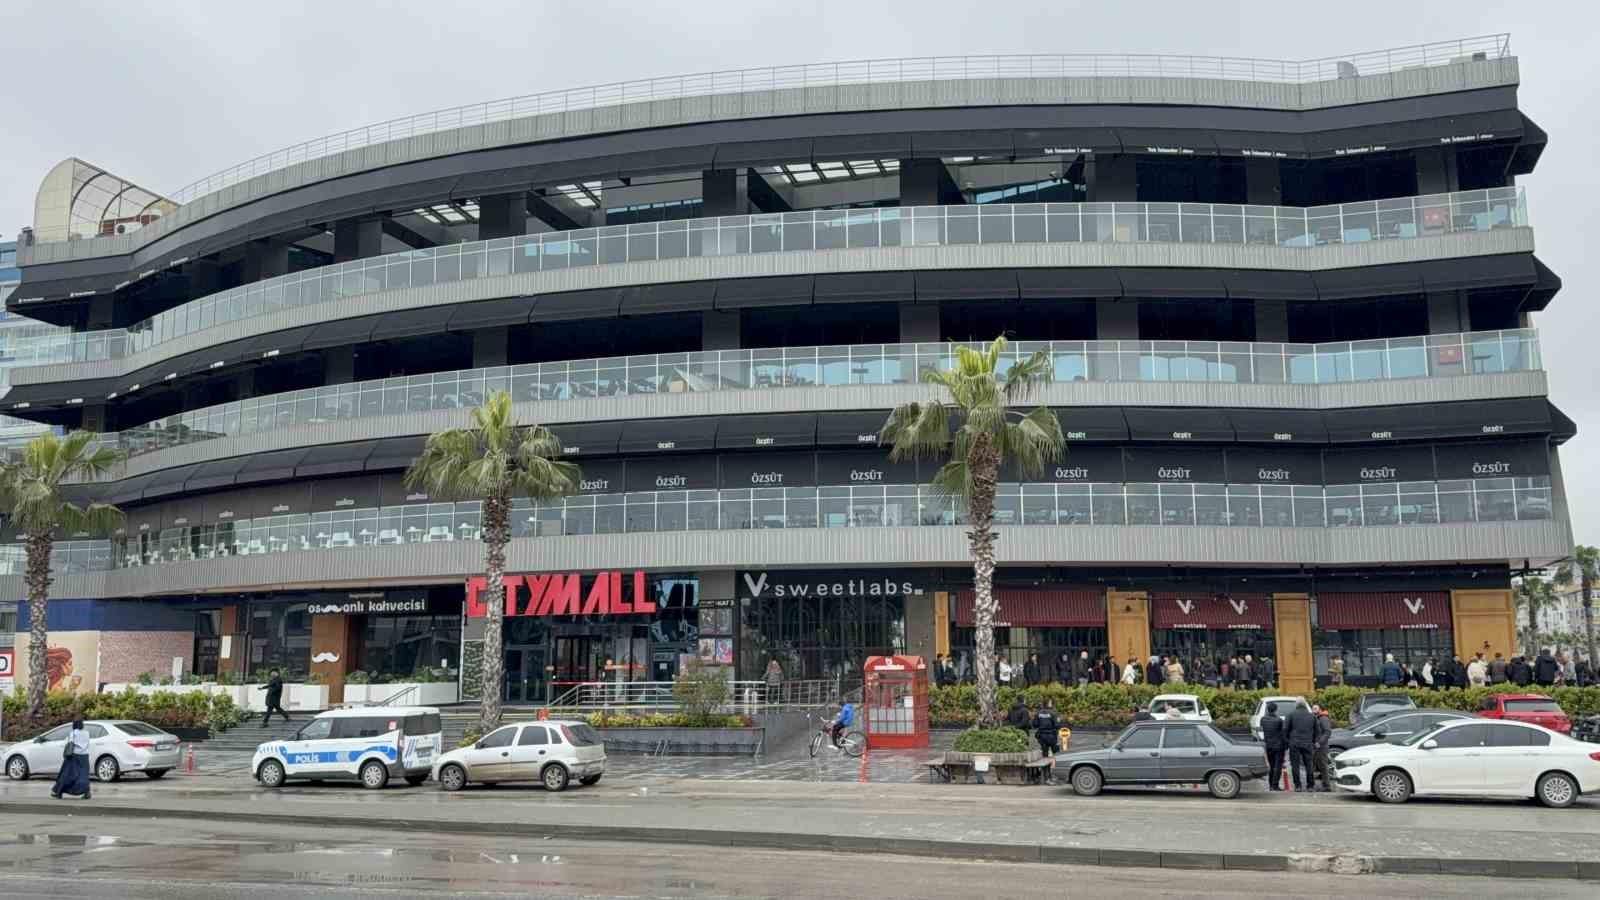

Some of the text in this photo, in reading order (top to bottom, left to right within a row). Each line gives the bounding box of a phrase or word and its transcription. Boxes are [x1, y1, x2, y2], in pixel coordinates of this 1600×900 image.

[1056, 467, 1089, 479] ÖZSÜT
[1158, 467, 1191, 479] ÖZSÜT
[1258, 468, 1290, 480] ÖZSÜT
[1360, 467, 1396, 479] ÖZSÜT
[1472, 462, 1510, 474] ÖZSÜT
[656, 475, 687, 487] ÖZSÜT
[751, 472, 783, 484] ÖZSÜT
[851, 470, 883, 481] ÖZSÜT
[580, 480, 609, 490] ÖZSÜT
[466, 570, 656, 617] CTYMALL
[308, 598, 425, 614] osanlı kahvecisi
[295, 752, 320, 763] POLİS
